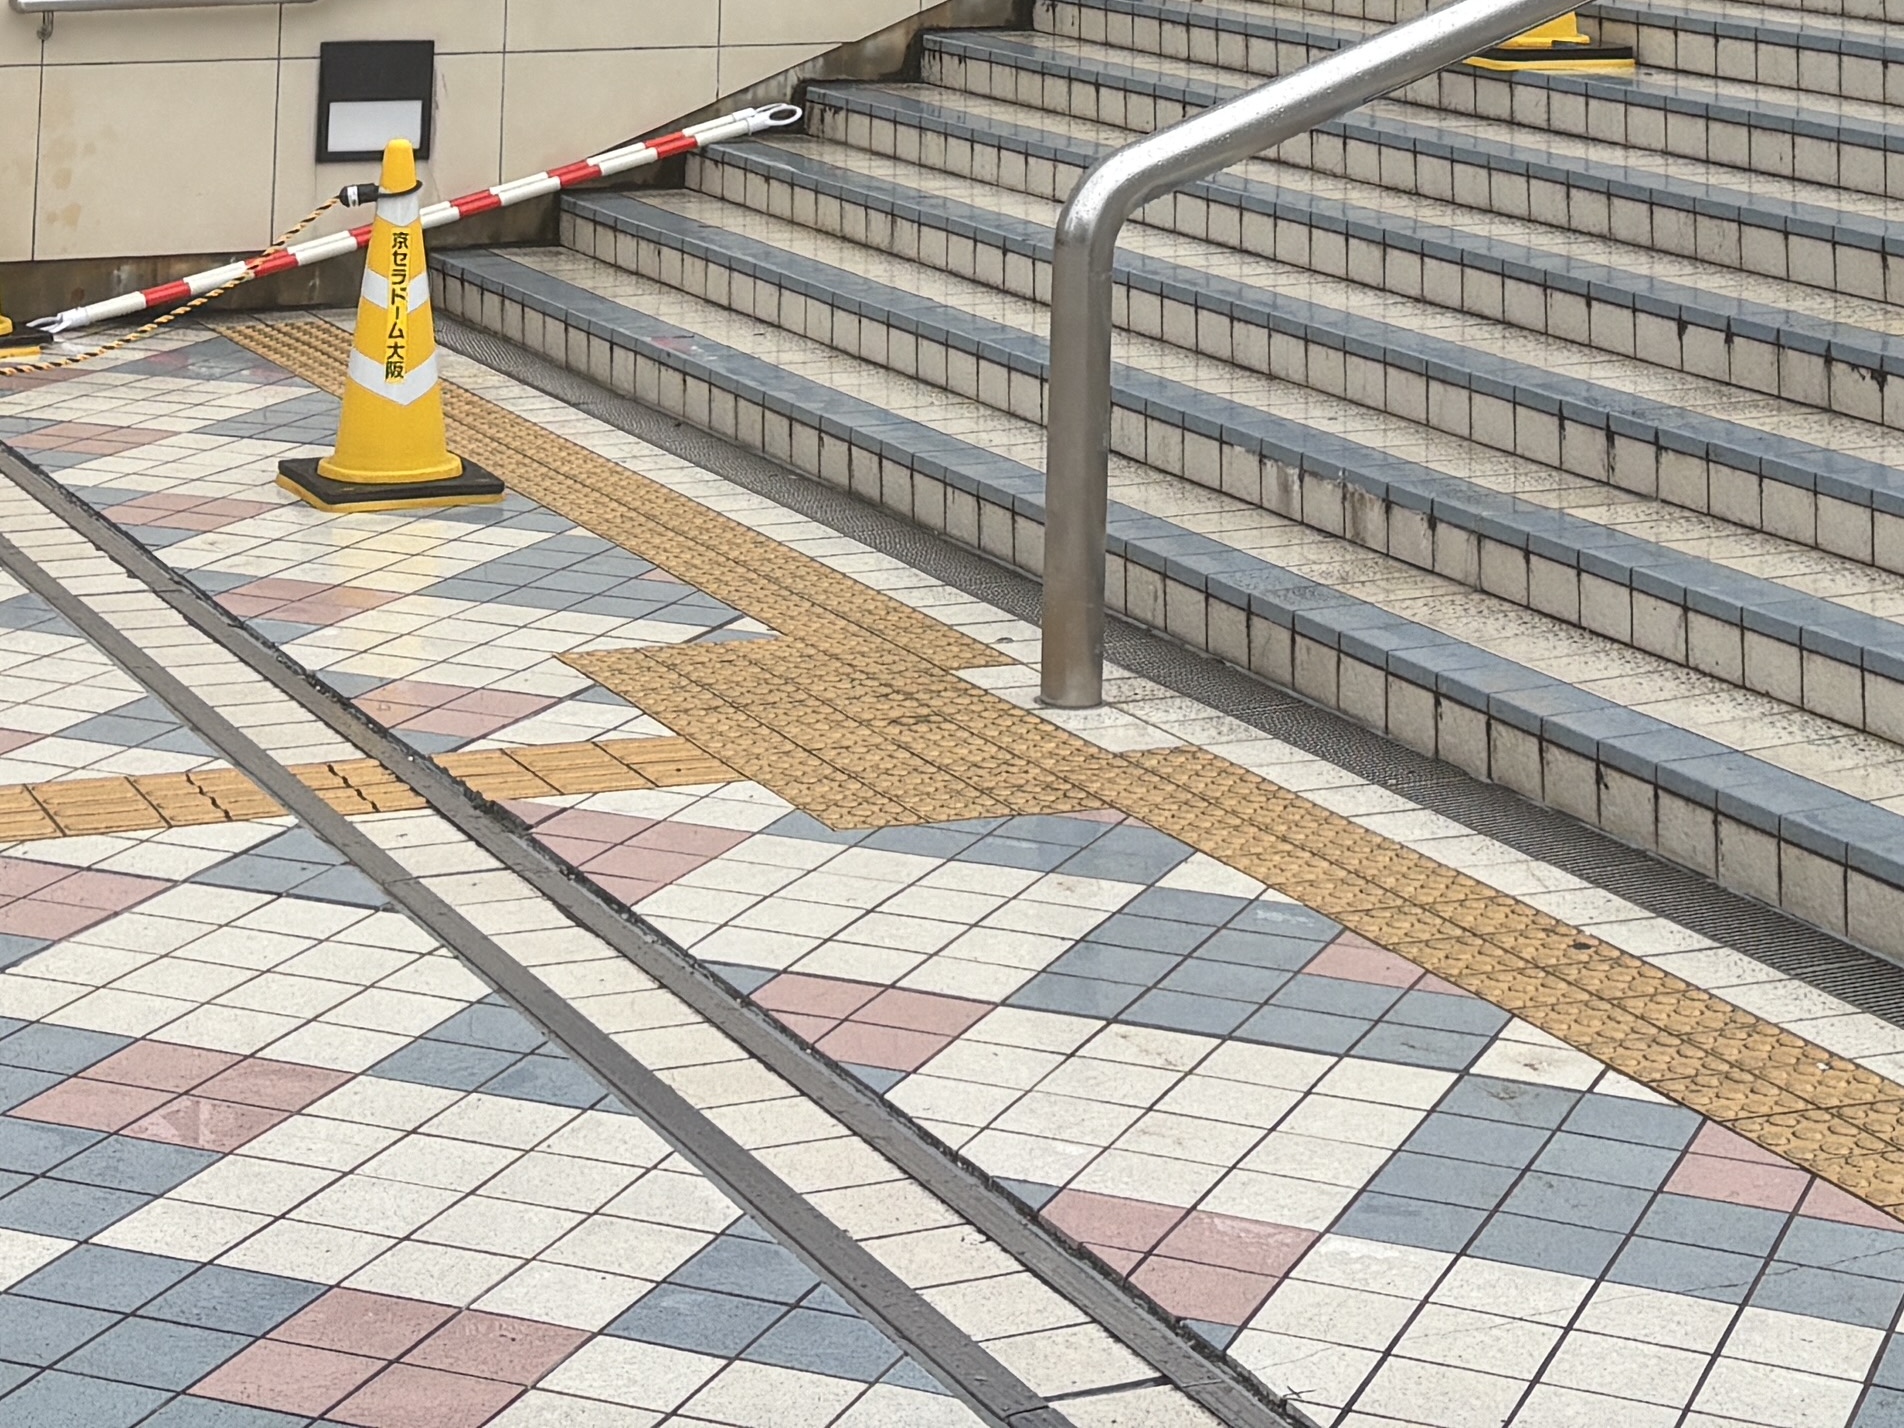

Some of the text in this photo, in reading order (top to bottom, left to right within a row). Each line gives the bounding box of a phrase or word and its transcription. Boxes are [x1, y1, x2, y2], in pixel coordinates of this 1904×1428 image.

[386, 232, 409, 380] 京セラドーム大阪
